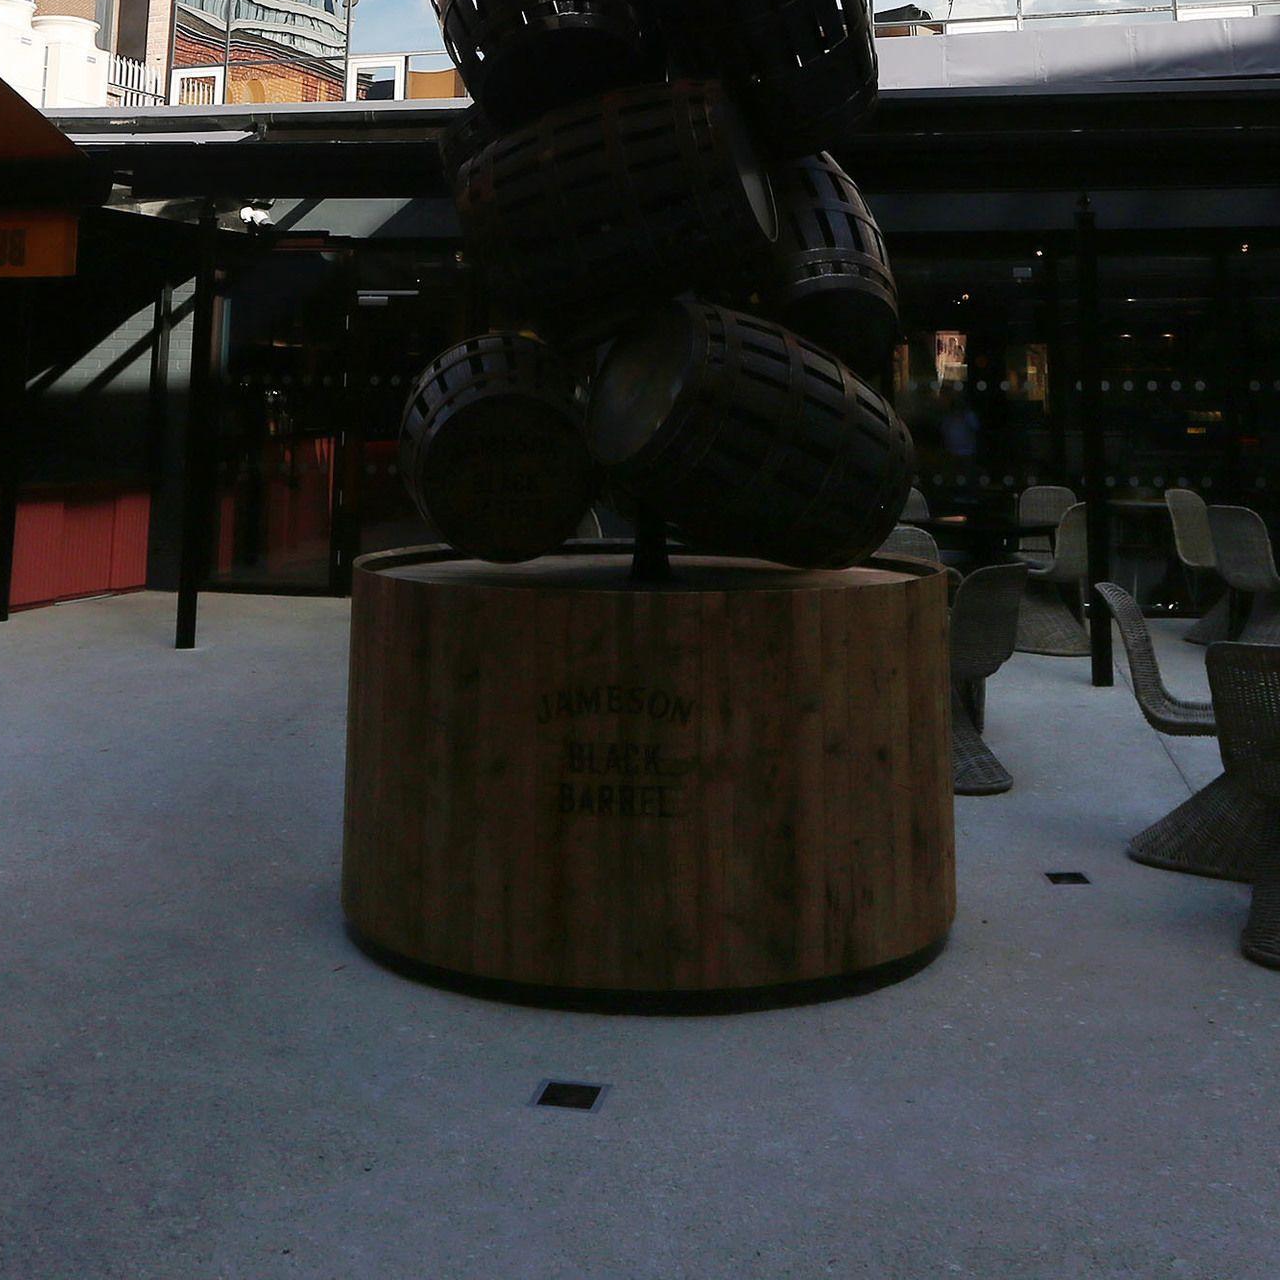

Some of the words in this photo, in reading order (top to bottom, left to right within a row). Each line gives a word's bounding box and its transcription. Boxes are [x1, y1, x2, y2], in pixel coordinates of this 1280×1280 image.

[537, 685, 696, 725] JAMESON
[567, 740, 662, 775] BLACK
[558, 783, 674, 818] BARREL
